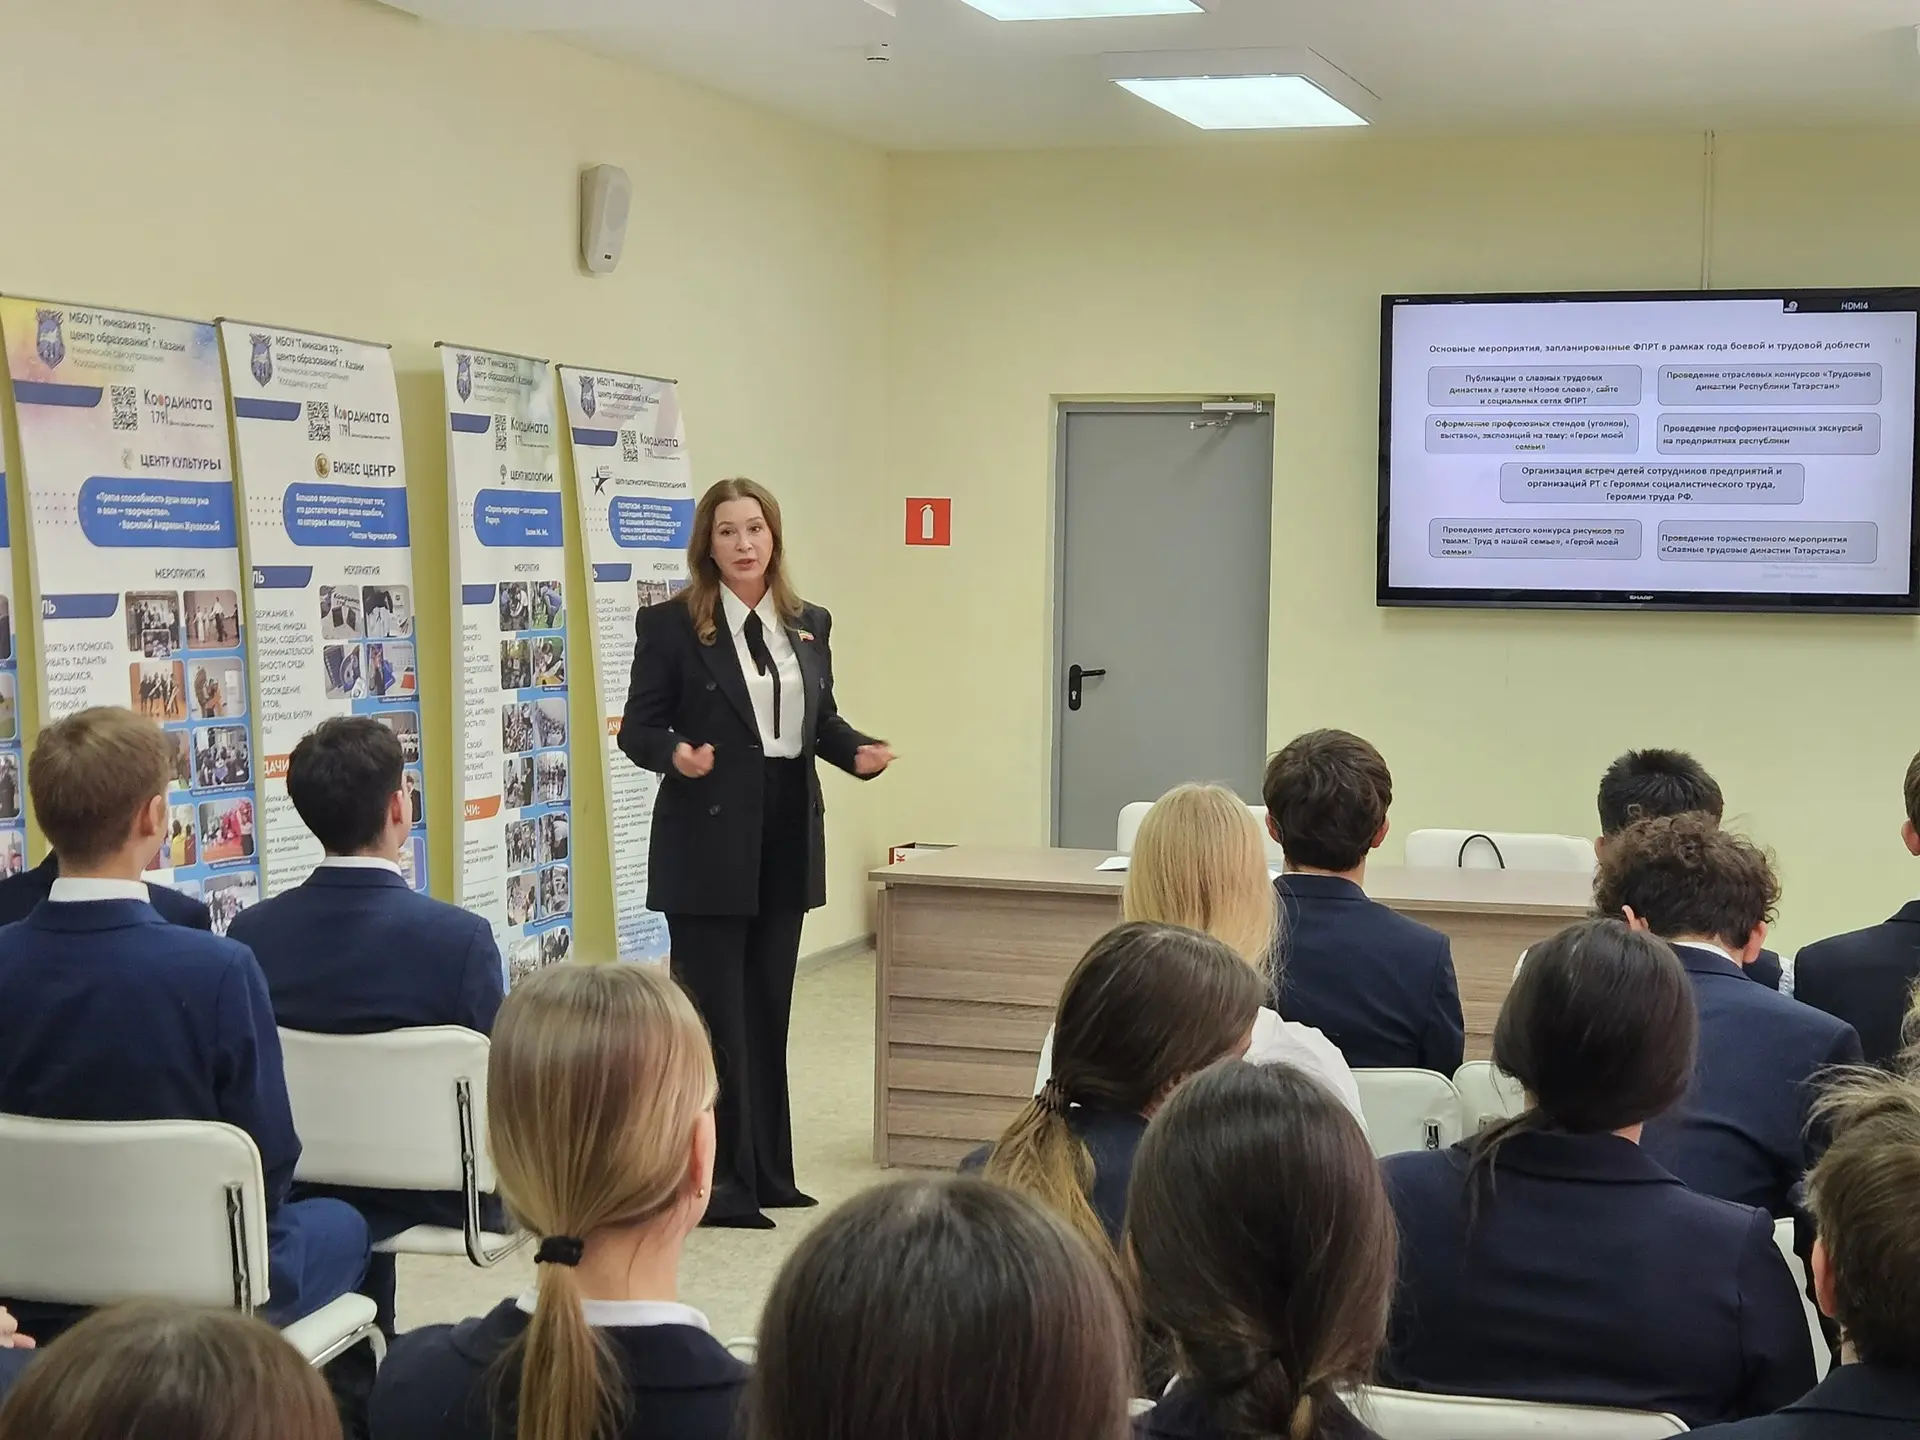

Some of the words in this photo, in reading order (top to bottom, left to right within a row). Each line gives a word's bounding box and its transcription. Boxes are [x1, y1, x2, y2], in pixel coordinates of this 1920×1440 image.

[1841, 302, 1869, 310] HDMI4
[69, 312, 93, 325] МБОУ
[138, 323, 151, 334] 179
[70, 330, 95, 344] центр
[159, 340, 186, 352] Казани
[276, 336, 295, 347] МБОУ
[1429, 344, 1476, 353] Основные
[1479, 345, 1543, 353] мероприятия,
[1545, 344, 1630, 353] запланированные
[1633, 343, 1659, 351] ФПРТ
[1670, 343, 1703, 352] рамках
[1731, 341, 1765, 349] боевой
[1777, 341, 1822, 350] трудовой
[1825, 341, 1870, 350] доблести
[276, 353, 296, 365] центр
[1465, 374, 1516, 382] Публикации
[1667, 371, 1719, 380] Проведение
[1775, 371, 1820, 379] конкурсов
[1823, 371, 1871, 379] «Трудовые
[1596, 385, 1618, 393] сайте
[1696, 383, 1736, 391] династии
[1739, 383, 1789, 391] Республики
[1488, 397, 1538, 405] социальных
[1564, 397, 1587, 405] ФПРТ
[151, 410, 165, 425] 179
[1435, 420, 1489, 428] Оформление
[1492, 420, 1550, 428] профсоюзных
[1552, 420, 1585, 428] стендов
[1588, 419, 1629, 429] (уголков),
[1663, 425, 1716, 433] Проведение
[1718, 425, 1816, 433] профориентационных
[1819, 424, 1863, 433] экскурсий
[1483, 431, 1530, 440] экспозиций
[1545, 433, 1567, 441] тему:
[1739, 437, 1790, 445] республики
[140, 454, 170, 468] ЦЕНТР
[171, 456, 221, 470] КУЛЬТУРЫ
[333, 461, 360, 475] БИЗНЕС
[363, 464, 396, 478] ЦЕНТР
[1522, 467, 1582, 476] Организация
[1585, 468, 1615, 476] встреч
[1617, 467, 1644, 475] детей
[1647, 467, 1707, 476] сотрудников
[1710, 467, 1774, 476] предприятий
[1527, 480, 1586, 488] организаций
[1610, 480, 1649, 489] Героями
[1652, 481, 1744, 489] социалистического
[1746, 481, 1775, 489] труда,
[1606, 493, 1646, 501] Героями
[1678, 493, 1693, 501] РФ.
[1442, 526, 1493, 534] Проведение
[1473, 538, 1492, 546] Труд
[1565, 538, 1594, 546] «Герой
[1662, 534, 1714, 543] Проведение
[1716, 535, 1786, 543] торжественного
[1789, 536, 1847, 544] мероприятия
[1706, 546, 1748, 554] трудовые
[1750, 547, 1791, 555] династии
[1793, 547, 1846, 555] Татарстана»
[155, 568, 206, 579] МЕРОПРИЯТИЯ
[72, 656, 107, 666] ТАЛАНТЫ
